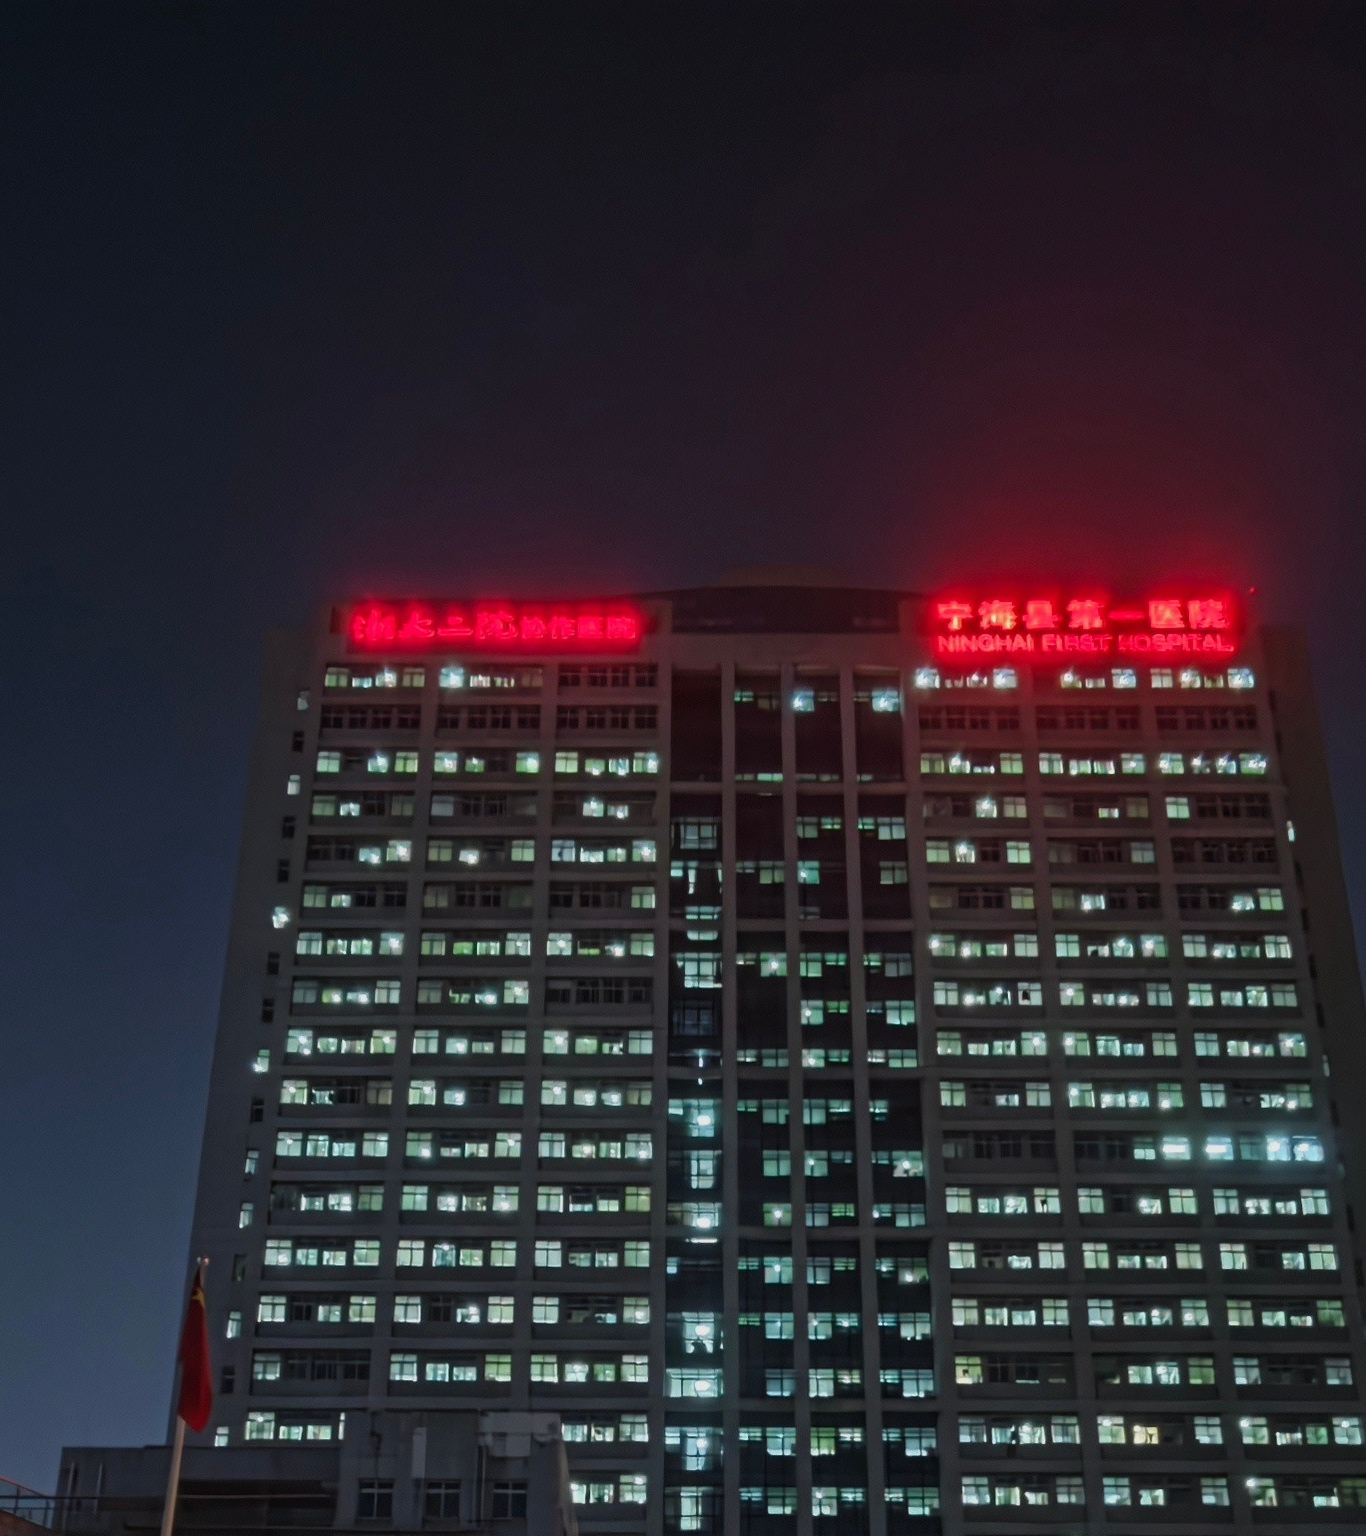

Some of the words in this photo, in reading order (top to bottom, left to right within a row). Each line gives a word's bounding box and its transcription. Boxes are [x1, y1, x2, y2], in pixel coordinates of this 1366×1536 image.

[937, 598, 1230, 629] 宁海县第一医院
[937, 633, 1035, 652] NINGHAI
[1041, 633, 1112, 652] FIRST
[1118, 633, 1234, 652] HOSPITAL
